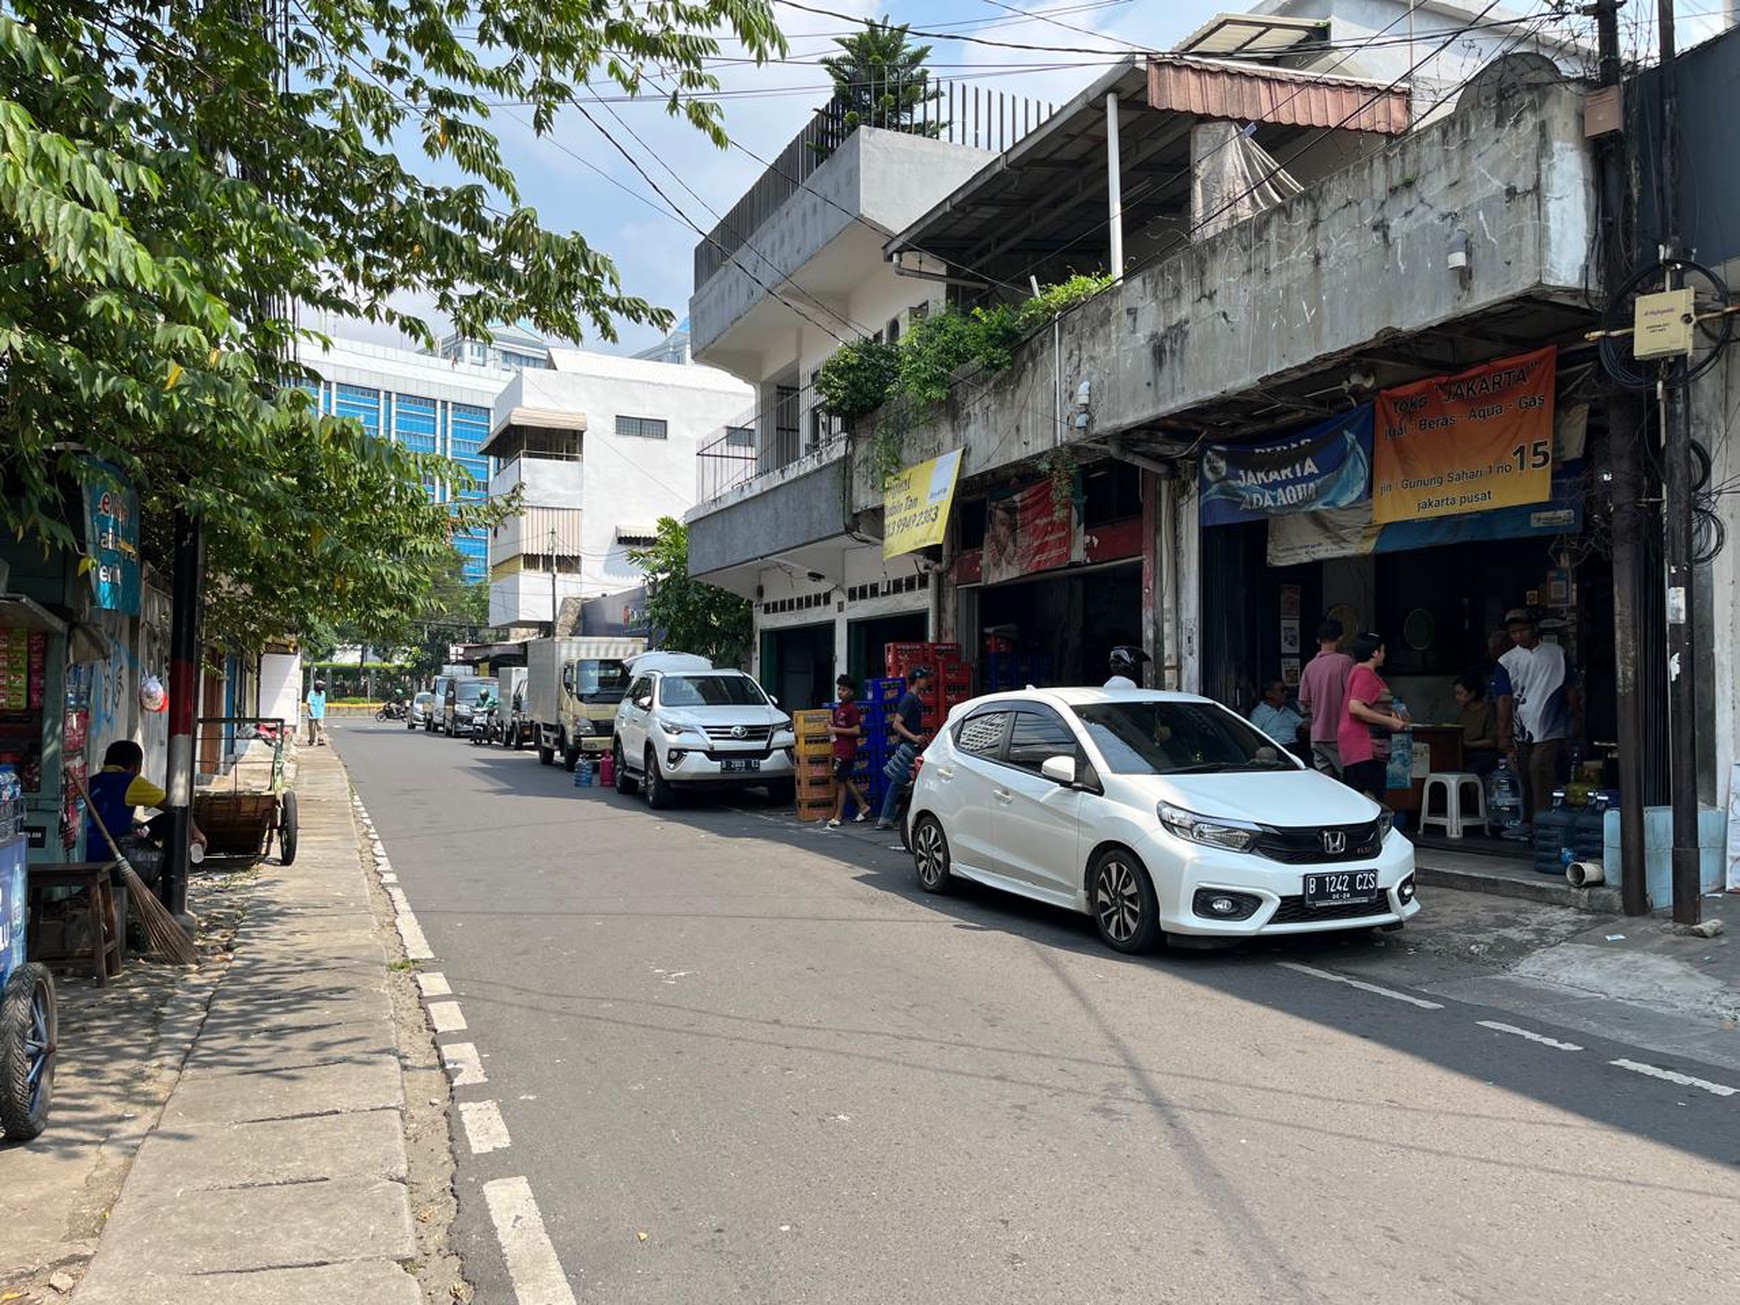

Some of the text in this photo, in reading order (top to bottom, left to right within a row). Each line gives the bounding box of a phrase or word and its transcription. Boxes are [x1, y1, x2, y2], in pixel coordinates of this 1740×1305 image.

[1419, 413, 1456, 431] Beras
[1468, 404, 1503, 422] Aqua
[1518, 394, 1545, 410] Gas
[1402, 475, 1444, 490] Gunung
[1447, 467, 1483, 482] Sahari
[1497, 463, 1513, 475] no
[1513, 439, 1552, 471] 15
[1416, 490, 1492, 513] jakarta pusat
[1309, 872, 1376, 894] B 1242 CZS
